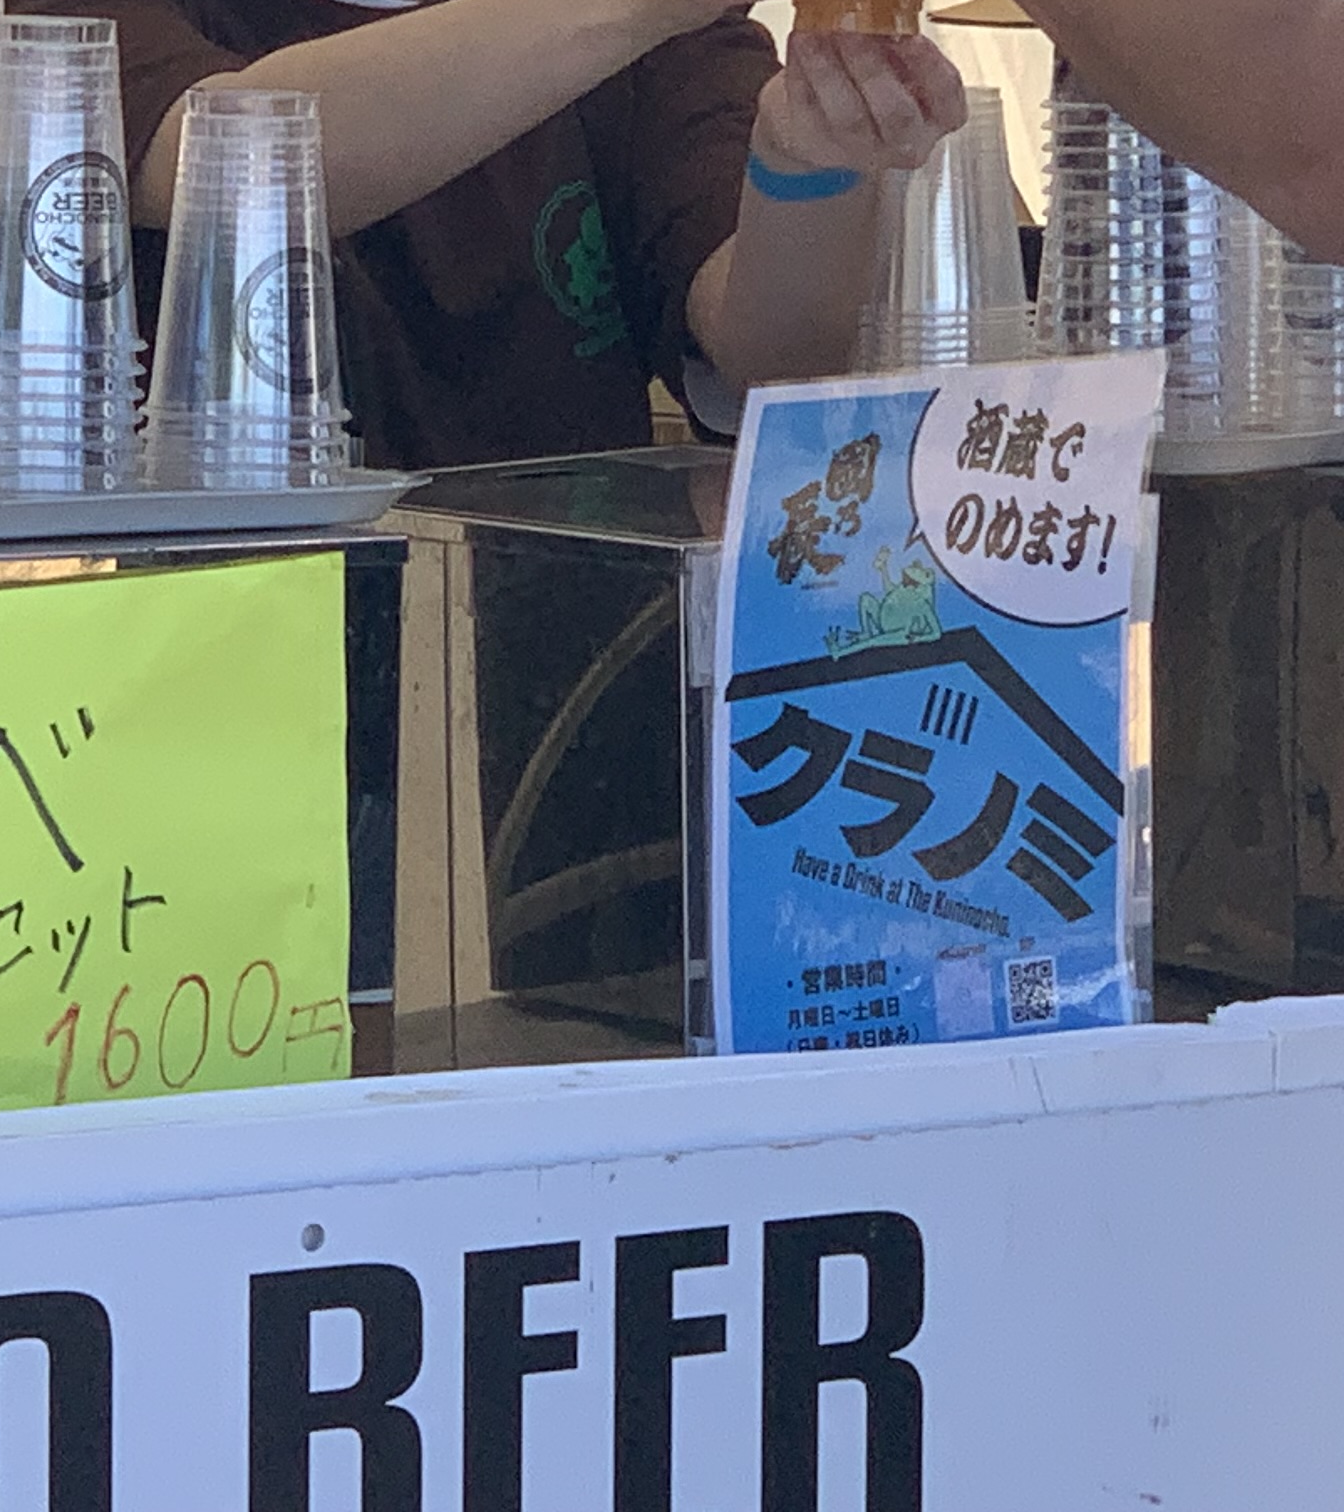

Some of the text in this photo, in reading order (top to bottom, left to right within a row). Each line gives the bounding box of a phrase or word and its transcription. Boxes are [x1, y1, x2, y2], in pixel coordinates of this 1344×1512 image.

[956, 398, 1086, 482] 酒蔵で
[731, 702, 1116, 923] クラノミ
[792, 846, 829, 882] Have
[905, 881, 932, 914] The
[45, 960, 348, 1108] 1600円
